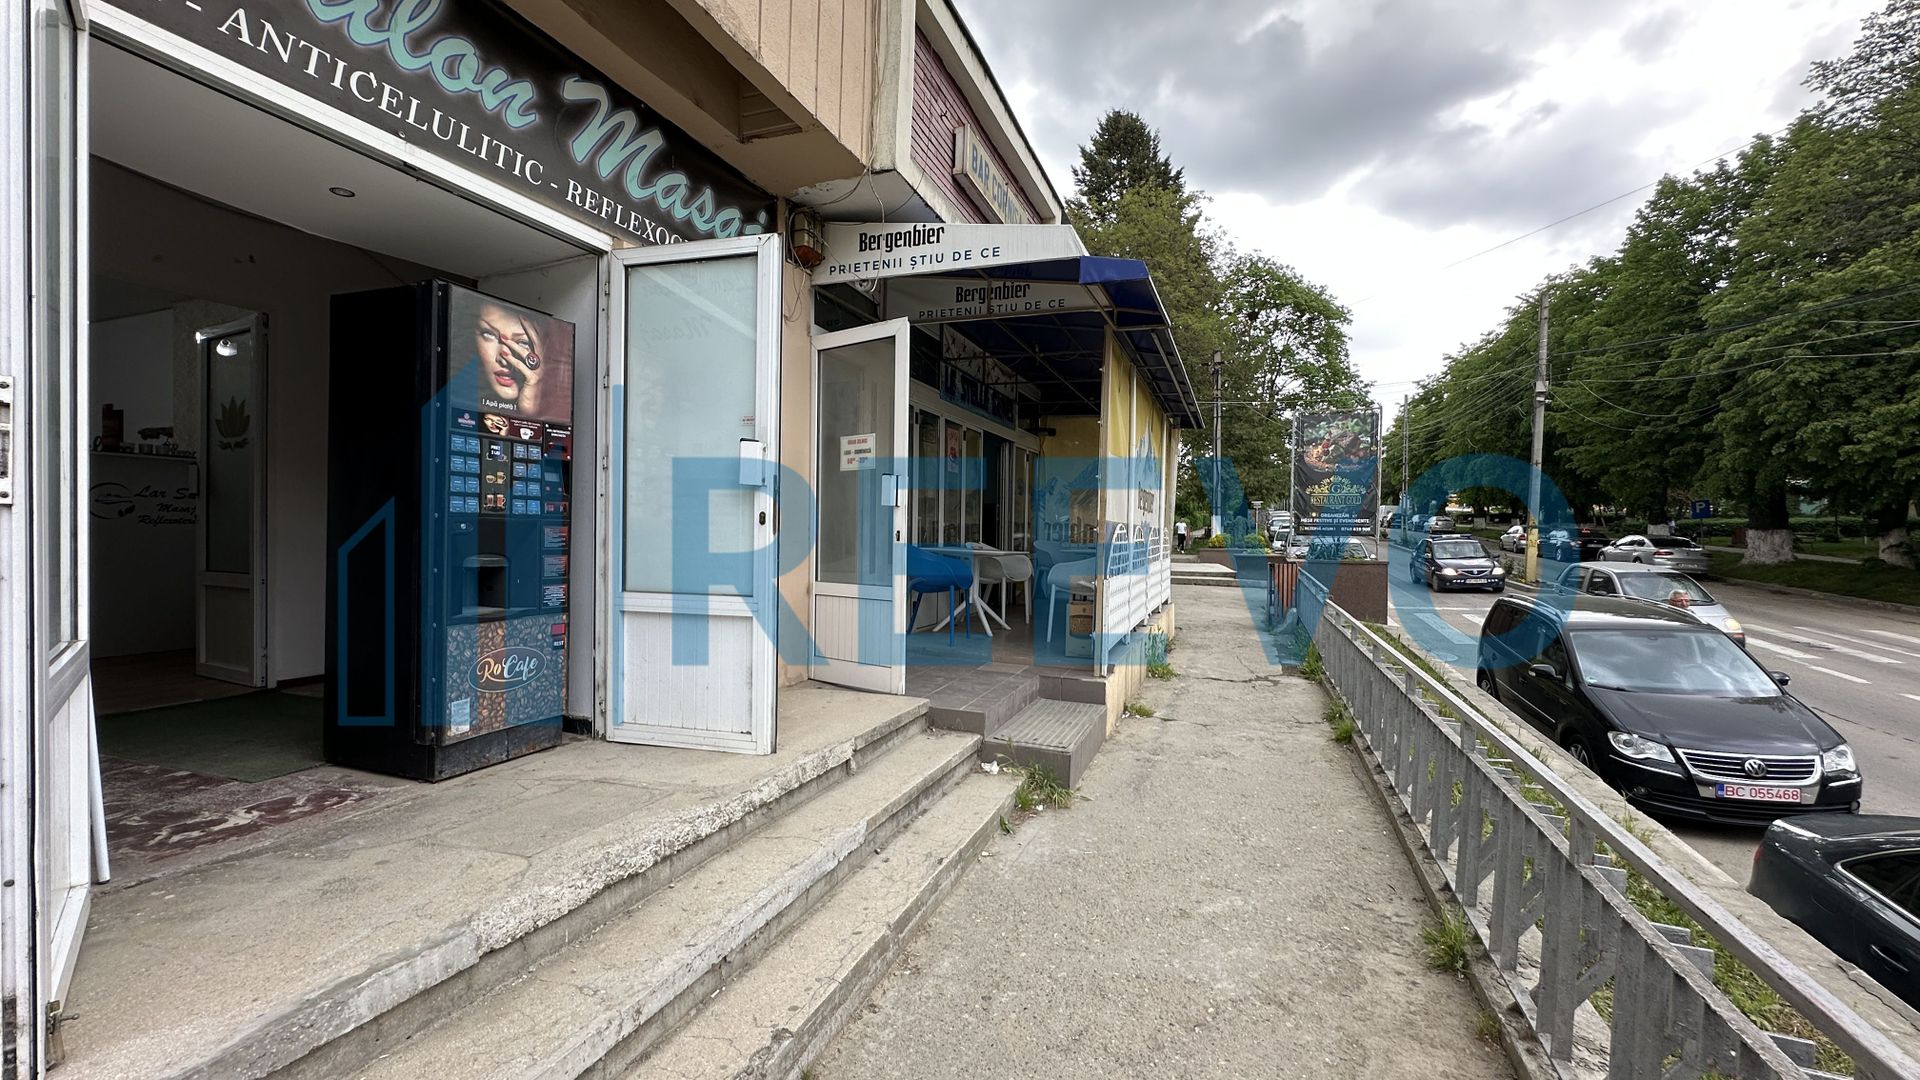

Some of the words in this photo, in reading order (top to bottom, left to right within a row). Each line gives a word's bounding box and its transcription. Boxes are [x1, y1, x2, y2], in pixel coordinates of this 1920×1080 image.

[217, 7, 544, 186] ANTICELULITIC
[971, 142, 990, 191] BAR
[858, 223, 945, 253] Bergenbier
[829, 257, 902, 276] PRIETENII
[910, 252, 945, 270] ȘTIU
[952, 249, 972, 262] DE
[980, 246, 1001, 259] CE
[919, 306, 982, 319] PRIETENII
[1024, 300, 1041, 310] DE
[1048, 298, 1065, 308] CE
[1346, 496, 1362, 505] GOLD
[1696, 502, 1706, 513] P
[1725, 785, 1745, 797] BC
[1749, 787, 1800, 801] 055468
